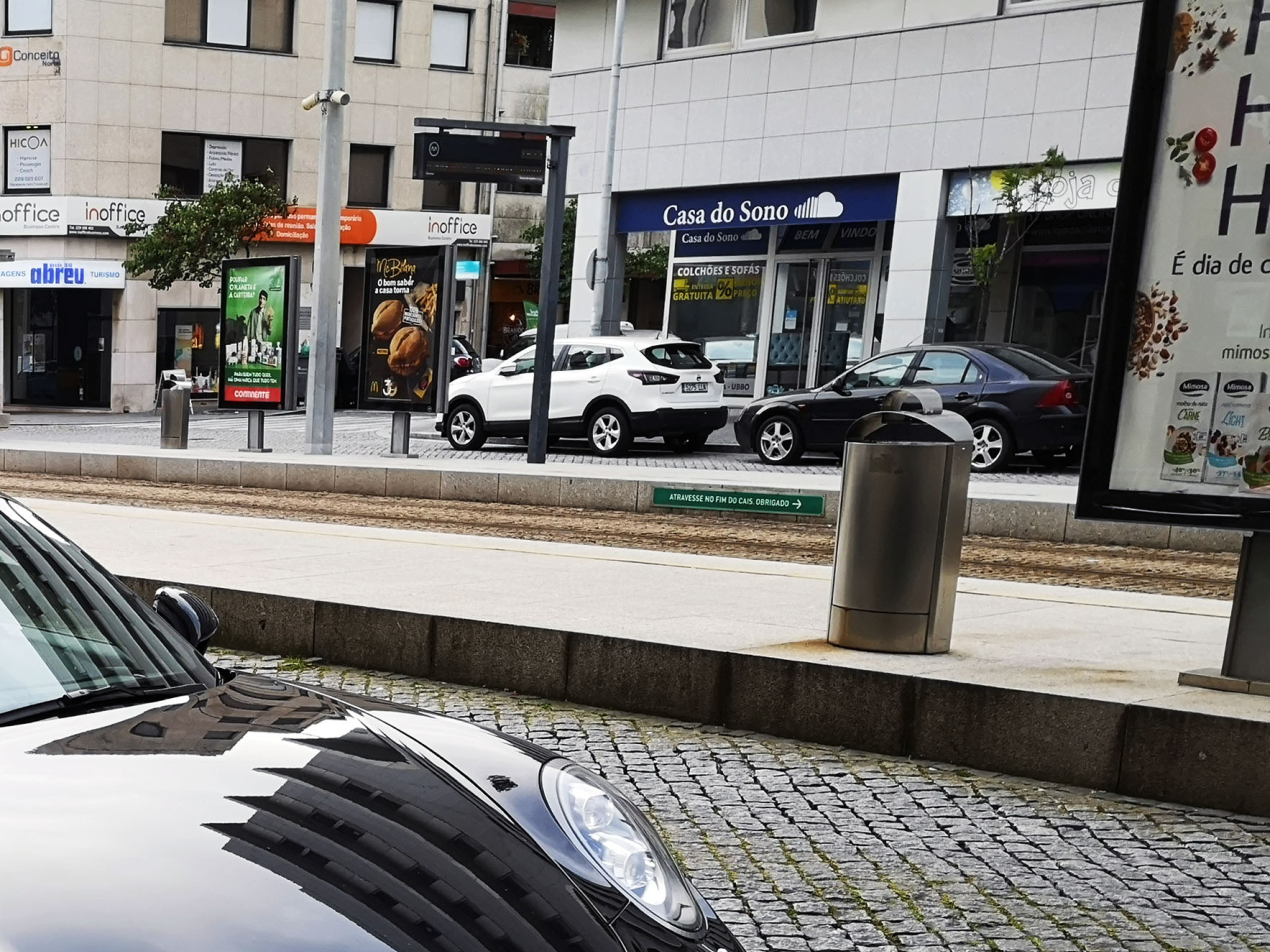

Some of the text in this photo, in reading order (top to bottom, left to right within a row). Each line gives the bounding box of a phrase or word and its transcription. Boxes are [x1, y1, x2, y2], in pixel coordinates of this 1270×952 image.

[13, 49, 60, 62] Conceito
[86, 202, 146, 222] inoffice
[663, 200, 789, 226] Casa do Sono
[428, 216, 478, 235] inoffice
[840, 226, 878, 239] VINDO
[681, 231, 739, 244] Casa do Sono
[794, 229, 820, 241] BEM
[1172, 250, 1186, 275] É
[1192, 252, 1222, 275] dia
[1228, 252, 1253, 275] de
[30, 263, 85, 285] abreu
[90, 271, 121, 279] TURISMO
[677, 263, 760, 277] COLCHÕES E SOFÁS
[382, 279, 397, 287] bom
[672, 291, 714, 300] GRATUITA
[669, 493, 704, 502] ATRAVESSE
[728, 496, 738, 504] DO
[738, 497, 754, 505] CAIS.
[755, 498, 790, 507] OBRIGADO
